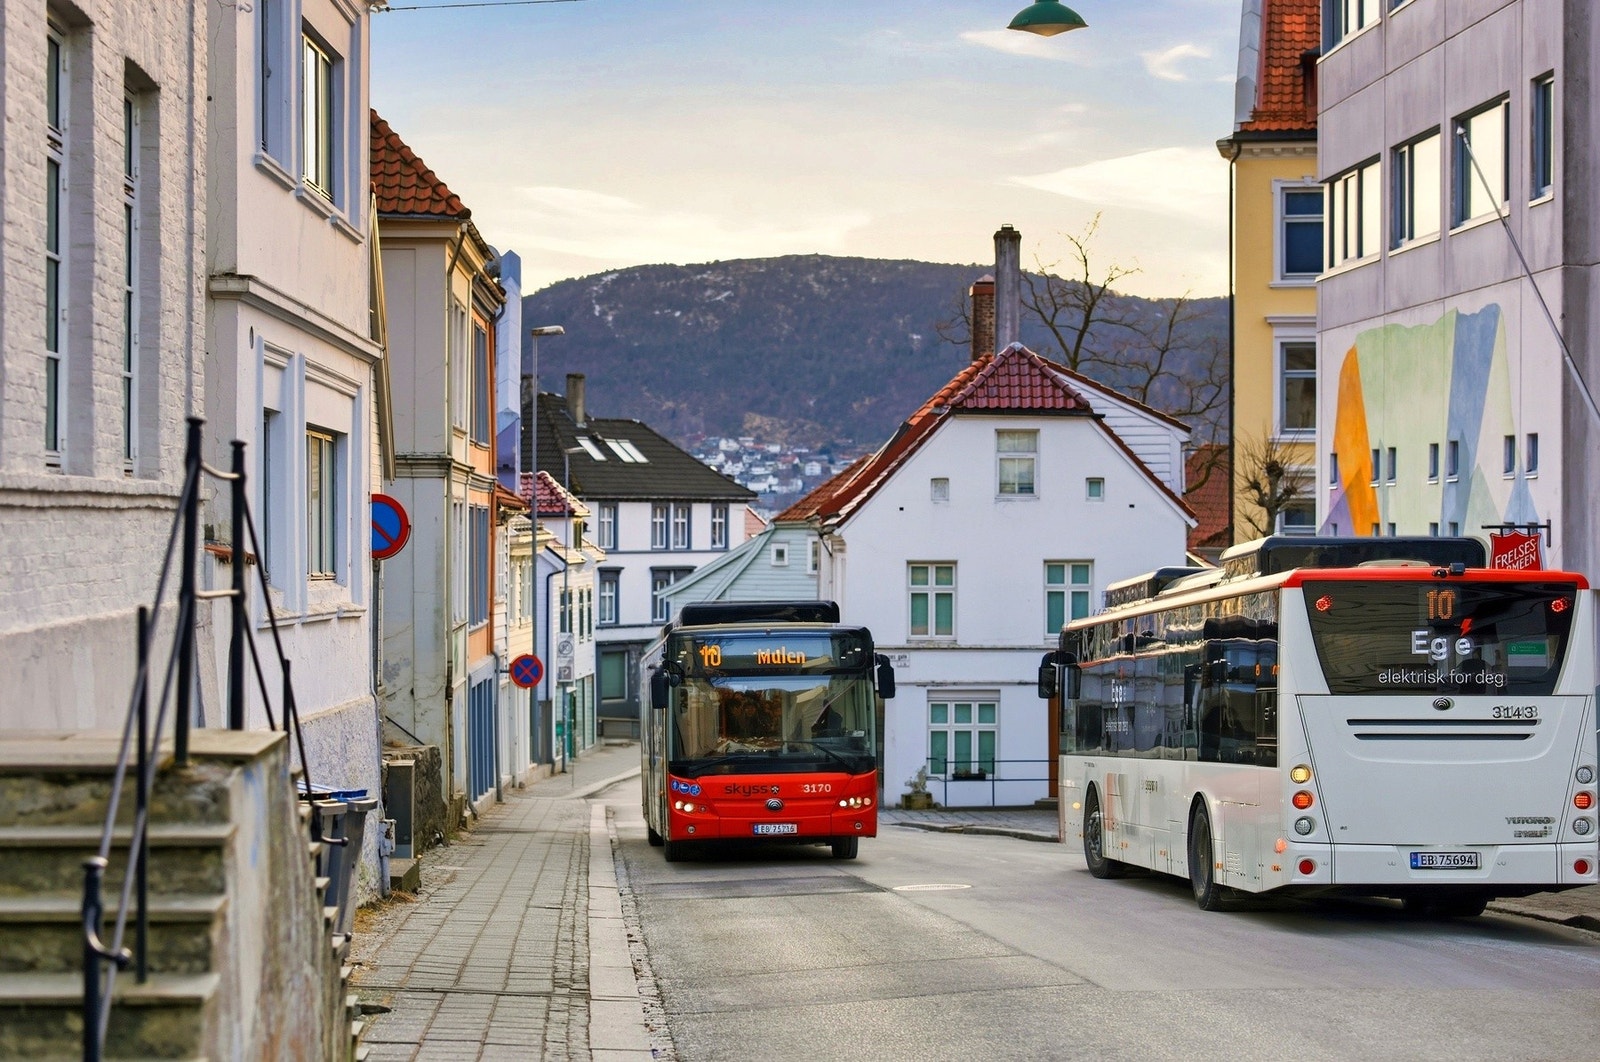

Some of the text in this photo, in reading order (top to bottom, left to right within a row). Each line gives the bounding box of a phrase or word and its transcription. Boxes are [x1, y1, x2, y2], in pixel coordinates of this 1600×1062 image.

[1427, 589, 1455, 619] 10
[701, 645, 721, 667] 10
[1378, 669, 1504, 688] elektrisk for deg
[1492, 706, 1535, 719] 3143
[725, 783, 768, 796] skyss
[803, 783, 832, 793] 3170
[1421, 855, 1474, 866] EB 75694
